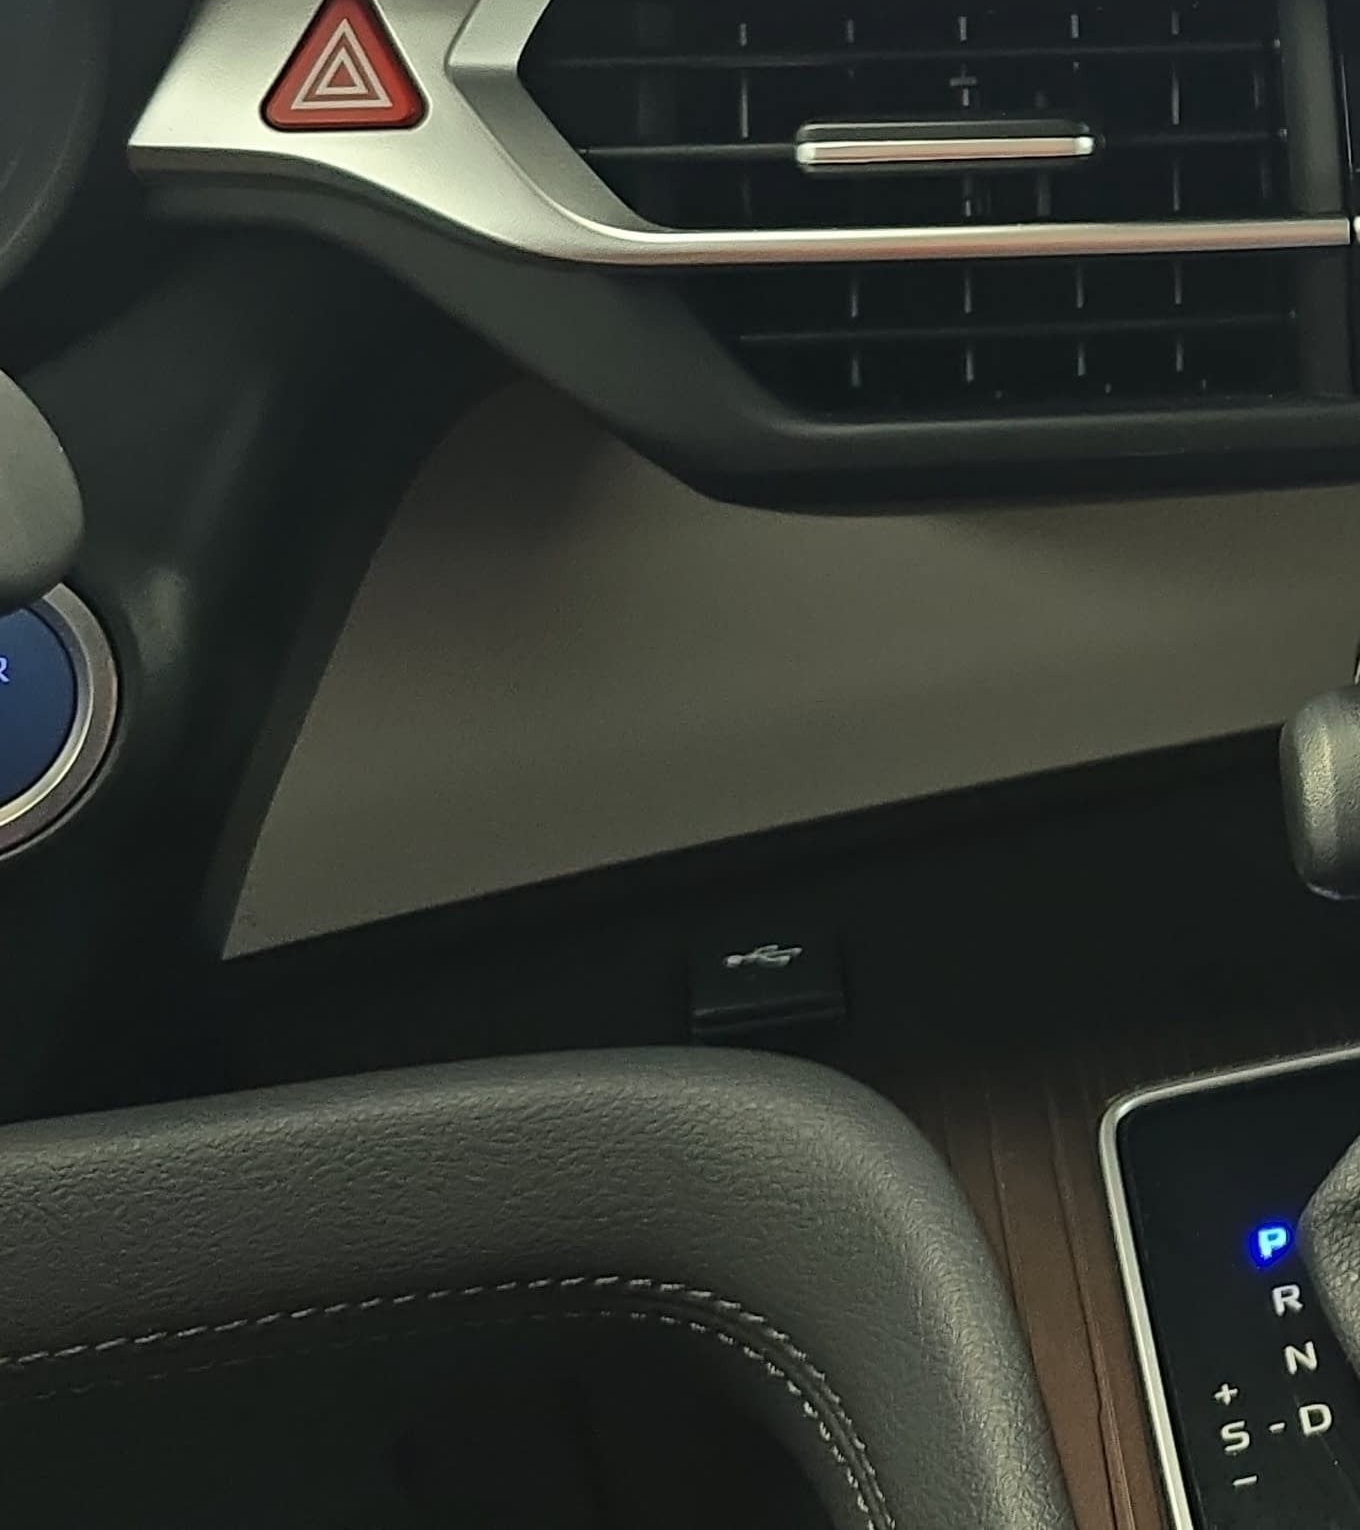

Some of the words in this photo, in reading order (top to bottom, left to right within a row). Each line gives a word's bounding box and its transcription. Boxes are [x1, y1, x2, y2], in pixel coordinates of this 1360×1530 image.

[1257, 1227, 1287, 1259] P
[1272, 1284, 1304, 1317] R
[1284, 1341, 1317, 1375] N
[1220, 1421, 1251, 1453] S
[1299, 1403, 1333, 1437] D
